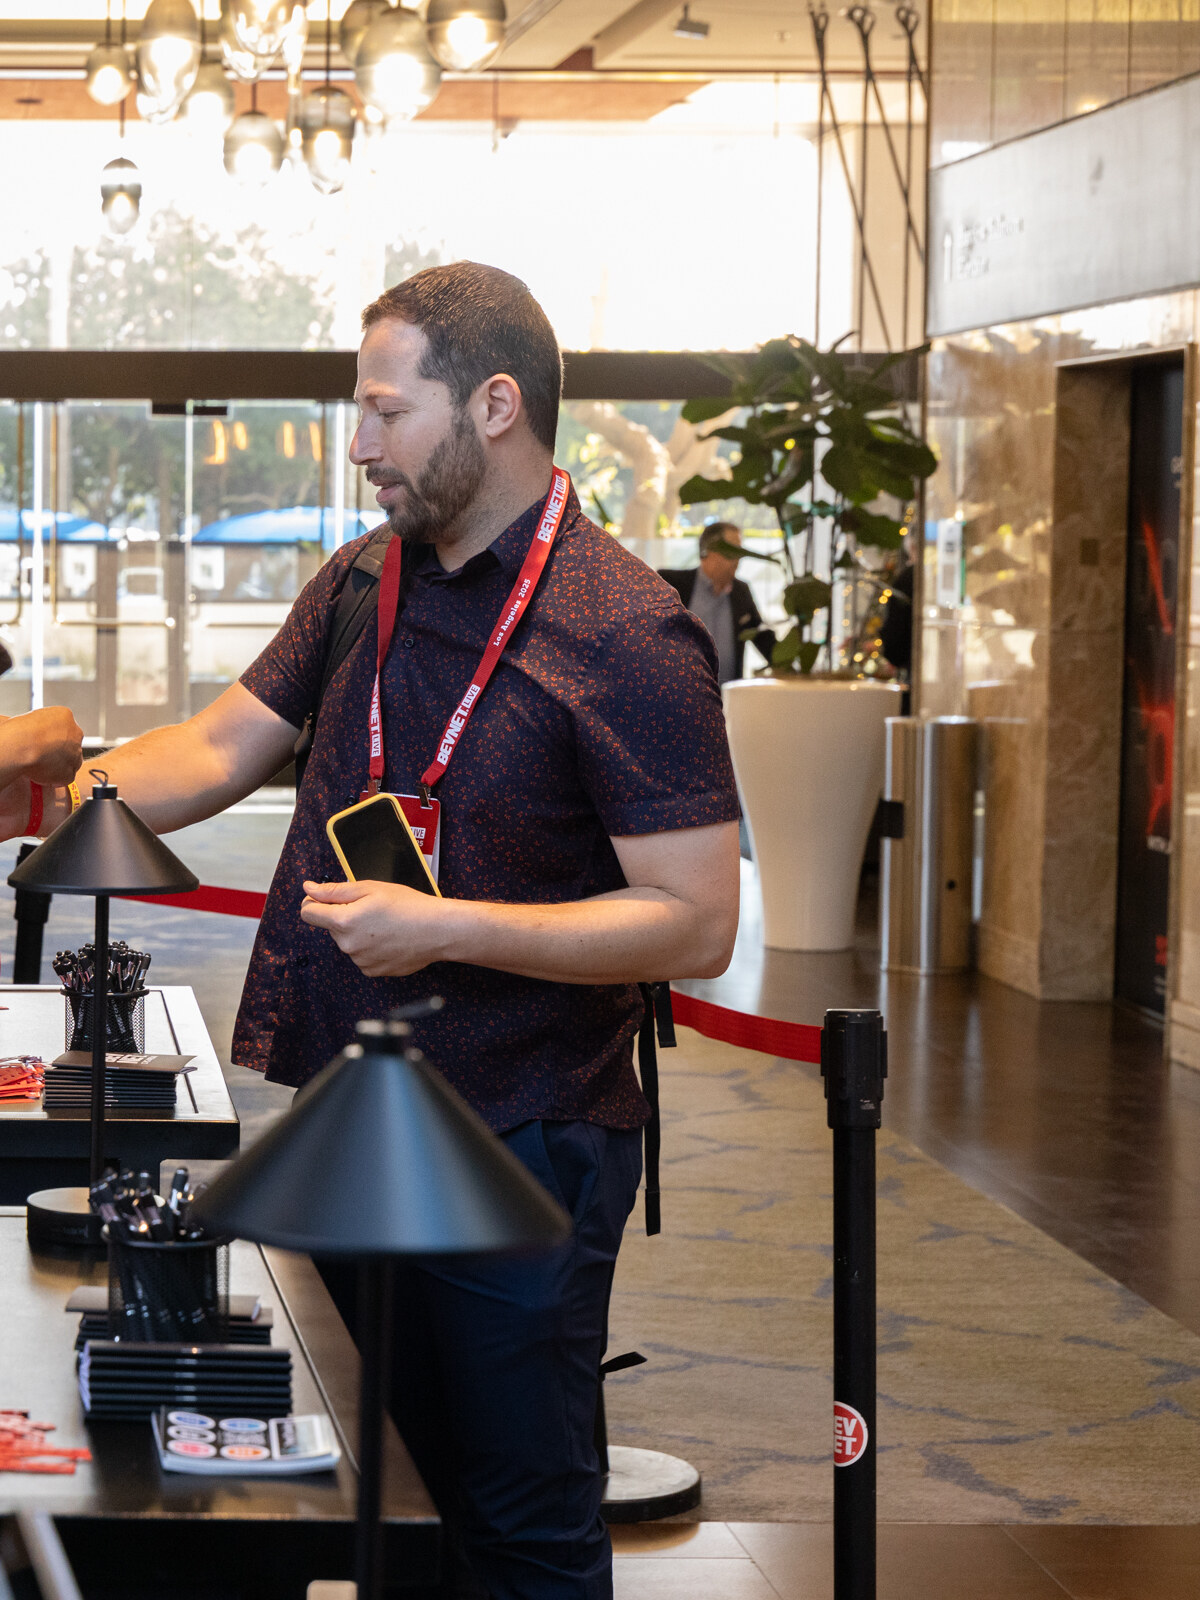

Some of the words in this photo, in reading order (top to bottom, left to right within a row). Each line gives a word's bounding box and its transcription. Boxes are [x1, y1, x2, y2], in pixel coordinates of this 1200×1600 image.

[493, 632, 504, 646] Los
[501, 600, 522, 631] Angeles
[518, 578, 531, 598] 2025
